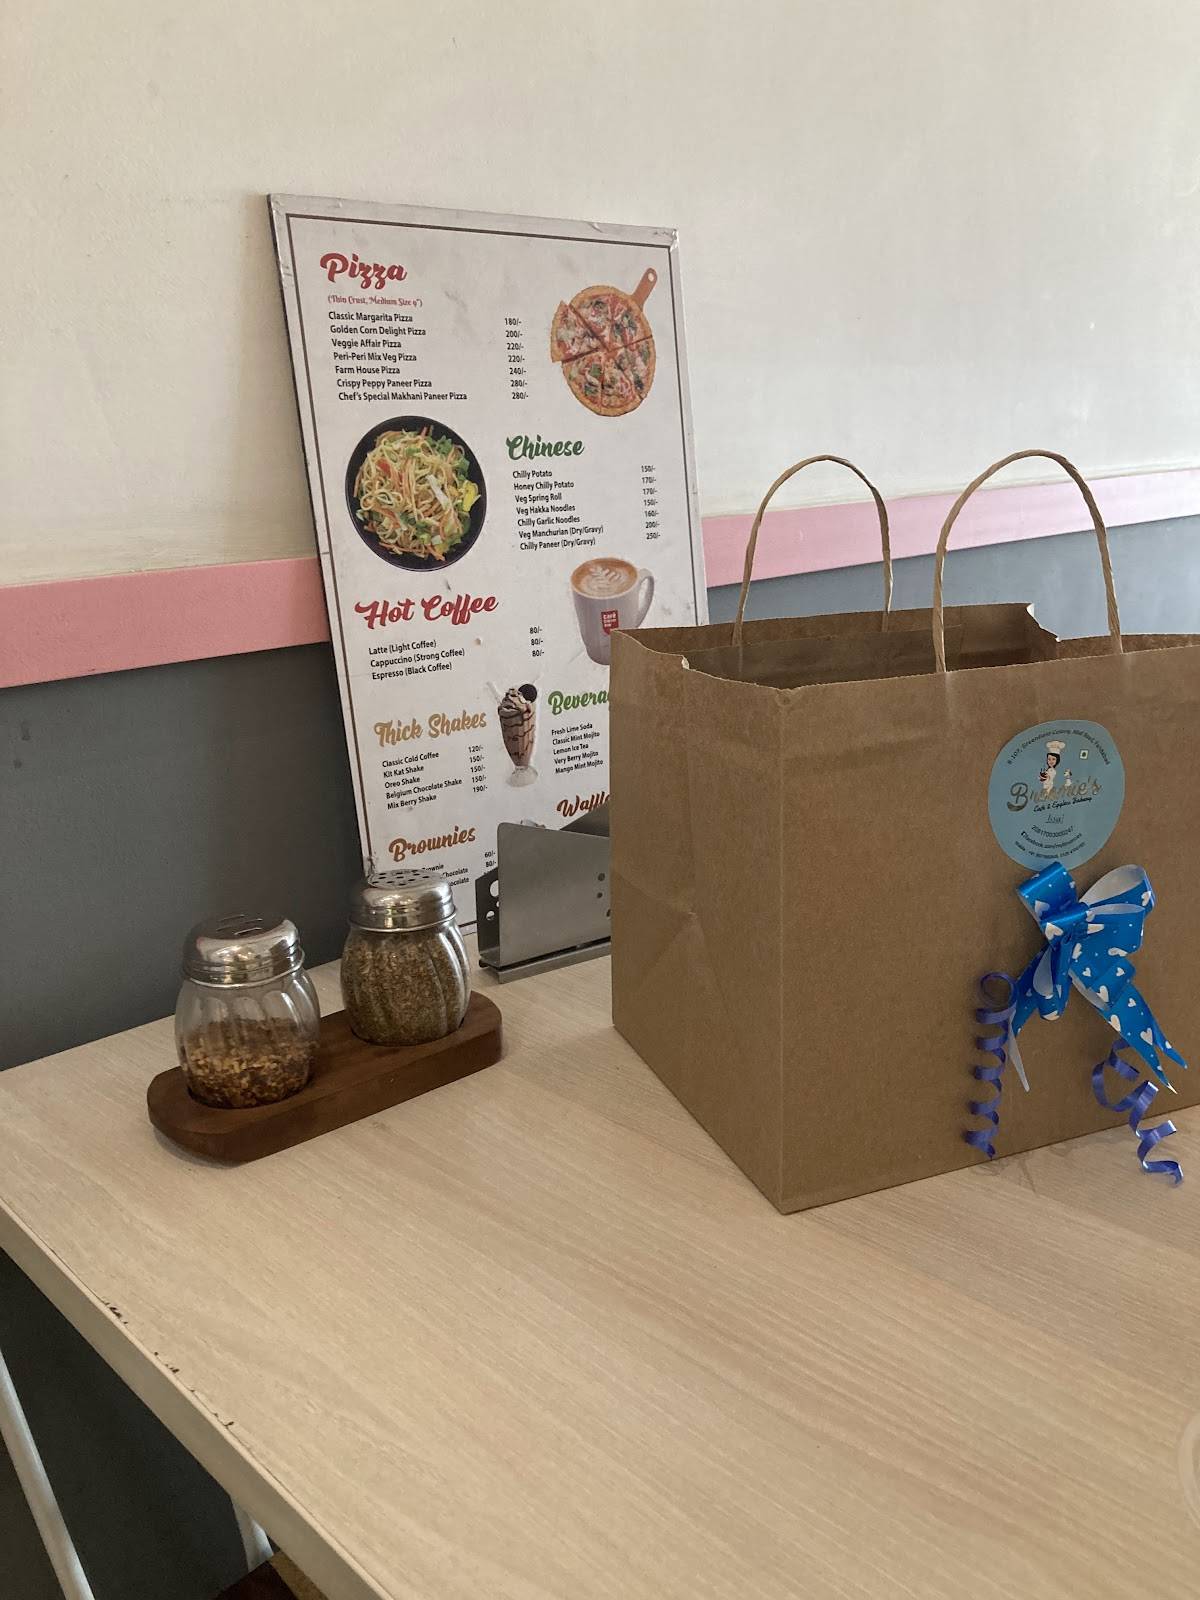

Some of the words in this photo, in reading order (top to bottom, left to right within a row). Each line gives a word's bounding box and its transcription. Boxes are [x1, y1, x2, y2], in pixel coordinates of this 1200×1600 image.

[320, 252, 407, 290] Pizza
[368, 295, 397, 305] Medium
[398, 298, 412, 306] Size
[328, 311, 355, 320] Classic
[355, 312, 393, 323] Margarita
[393, 313, 413, 322] Pizza
[504, 317, 522, 326] 180/-
[330, 325, 358, 334] Golden
[359, 325, 378, 334] Corn
[379, 326, 406, 337] Delight
[407, 327, 426, 336] Pizza
[505, 330, 523, 338] 200/-
[331, 338, 358, 349] Veggie
[360, 339, 381, 347] Affair
[382, 339, 402, 348] Pizza
[506, 342, 524, 351] 220/-
[333, 352, 366, 361] Peri-Peri
[367, 352, 382, 361] Mix
[382, 353, 397, 363] Veg
[398, 353, 417, 361] Pizza
[508, 355, 525, 363] 220/-
[335, 365, 355, 374] Farm
[356, 366, 380, 374] House
[381, 366, 400, 374] Pizza
[509, 367, 527, 375] 240/-
[337, 378, 361, 389] Crispy
[362, 379, 385, 389] Peppy
[387, 379, 412, 387] Paneer
[413, 379, 432, 387] Pizza
[510, 380, 528, 388] 280/-
[338, 392, 362, 401] Chef's
[363, 392, 390, 403] Special
[391, 392, 423, 400] Makhani
[423, 392, 448, 400] Paneer
[449, 392, 467, 400] Pizza
[512, 392, 529, 400] 280/-
[506, 434, 585, 461] Chinese
[512, 470, 531, 480] Chilly
[531, 470, 552, 478] Potato
[513, 483, 534, 491] Honey
[535, 481, 553, 491] Chilly
[514, 495, 528, 504] Veg
[528, 494, 549, 504] Spring
[550, 492, 562, 501] Roll
[516, 507, 529, 516] Veg
[529, 505, 550, 514] Hakka
[550, 504, 576, 512] Noodles
[517, 518, 535, 527] Chilly
[536, 517, 554, 525] Garlic
[555, 515, 580, 524] Noodles
[518, 531, 531, 540] Veg
[532, 528, 569, 537] Manchurian
[520, 542, 538, 551] Chilly
[538, 541, 560, 549] Paneer
[354, 597, 415, 630] Hot
[421, 593, 499, 626] Coffee
[368, 647, 388, 655] Latte
[529, 625, 543, 634] 80/-
[370, 656, 413, 668] Cappuccino
[530, 638, 544, 646] 80/-
[371, 670, 404, 681] Espresso
[532, 649, 545, 657] 80/-
[548, 690, 609, 716] Bevera
[373, 718, 423, 748] Thick
[428, 709, 488, 739] Shakes
[551, 727, 566, 736] Fresh
[579, 723, 593, 731] Soda
[552, 737, 570, 745] Classic
[583, 731, 600, 739] Mojito
[553, 747, 571, 755] Lemon
[582, 751, 599, 759] Mojito
[382, 758, 403, 768] Classic
[404, 755, 419, 763] Cold
[419, 752, 439, 761] Coffee
[405, 765, 424, 774] Shake
[555, 766, 573, 774] Mango
[574, 762, 586, 770] Mint
[586, 760, 603, 768] Mojito
[384, 781, 401, 789] Oreo
[401, 776, 420, 786] Shake
[386, 789, 412, 799] Belgium
[413, 783, 443, 794] Chocolate
[444, 778, 462, 787] Shake
[387, 802, 399, 810] Mix
[400, 799, 417, 807] Berry
[418, 794, 437, 803] Shake
[388, 825, 476, 863] Brownies
